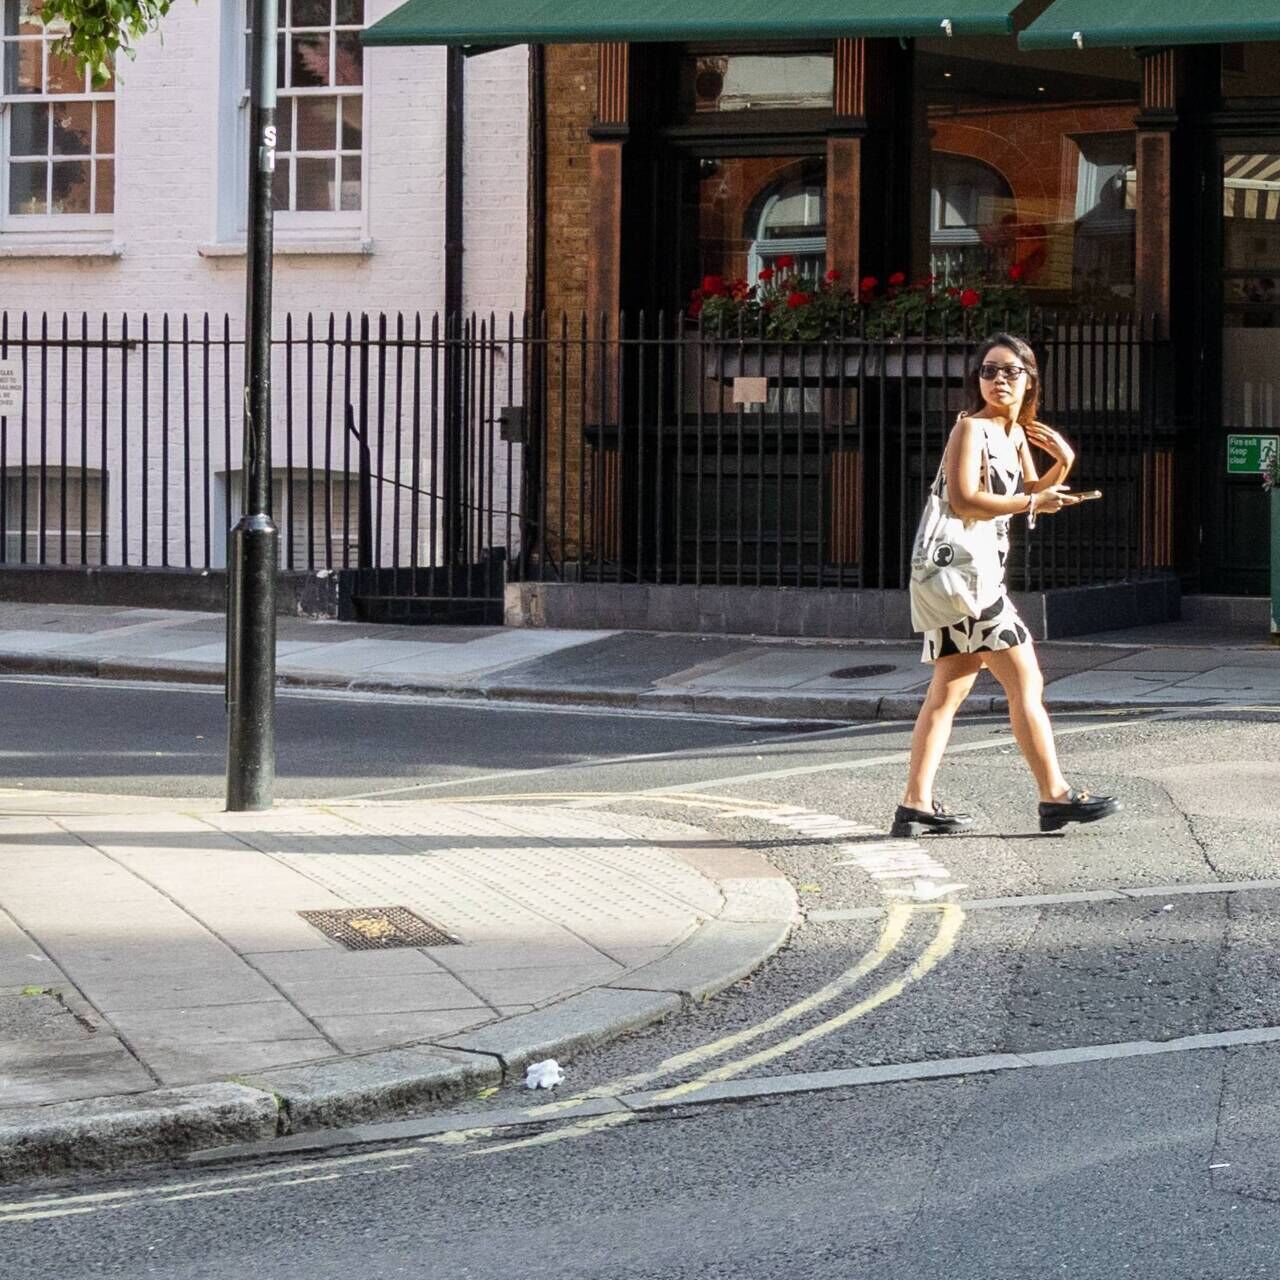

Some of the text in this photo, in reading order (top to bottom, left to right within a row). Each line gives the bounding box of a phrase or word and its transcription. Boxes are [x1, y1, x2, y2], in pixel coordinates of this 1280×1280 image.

[1230, 437, 1257, 446] Fire exit
[1230, 447, 1248, 457] Keep
